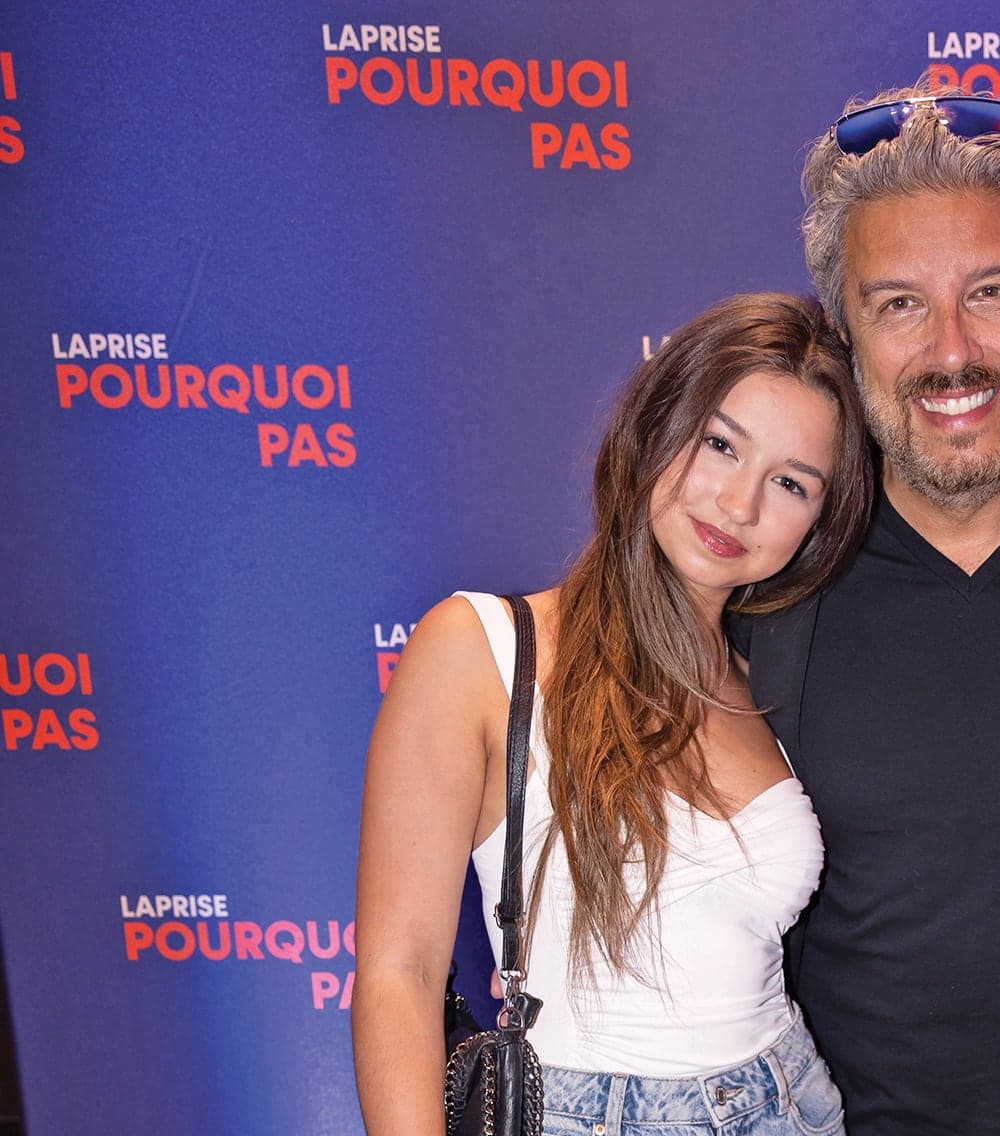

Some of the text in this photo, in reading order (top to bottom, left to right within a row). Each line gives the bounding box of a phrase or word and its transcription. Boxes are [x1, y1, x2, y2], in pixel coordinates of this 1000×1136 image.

[323, 24, 441, 52] LAPRISE
[326, 57, 627, 112] POURQUOI
[531, 123, 630, 169] PAS
[52, 334, 168, 359] LAPRISE
[56, 364, 351, 413] POURQUOI
[258, 424, 356, 467] PAS
[2, 708, 98, 750] PAS
[120, 895, 228, 917] LAPRISE
[124, 921, 356, 963] POURQU
